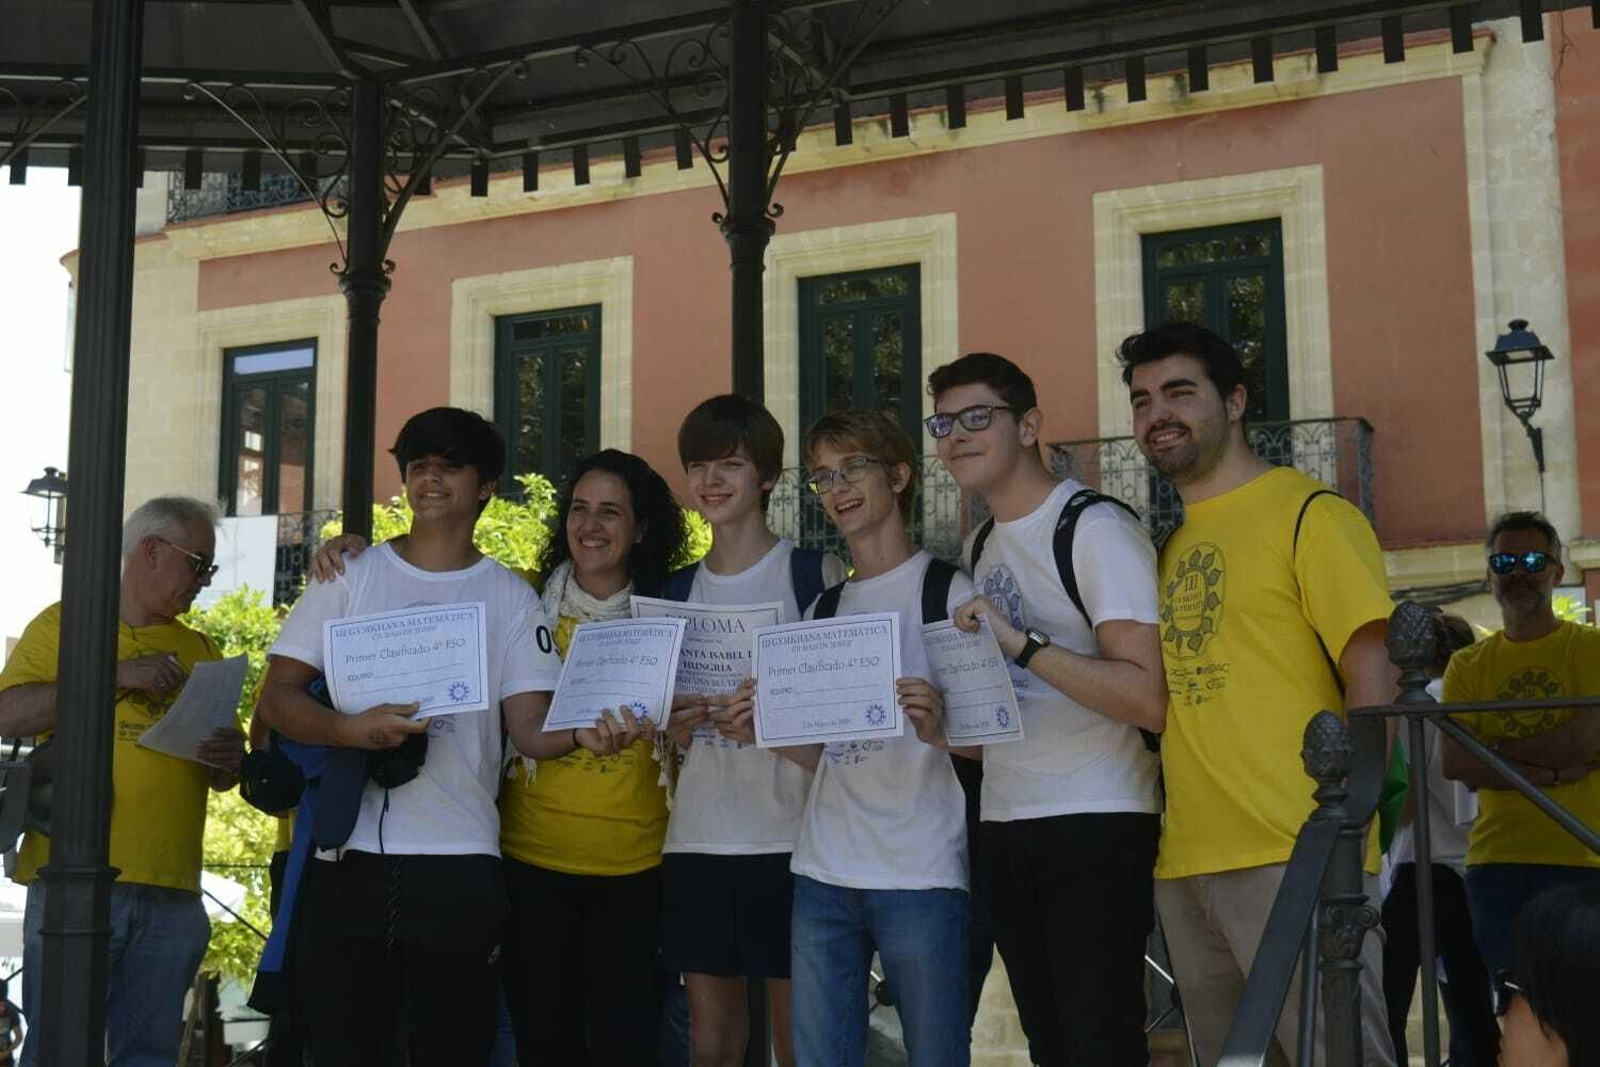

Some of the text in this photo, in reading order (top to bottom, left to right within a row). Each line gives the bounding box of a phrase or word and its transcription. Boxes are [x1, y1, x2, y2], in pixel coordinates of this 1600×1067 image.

[345, 652, 377, 665] Primer
[379, 642, 432, 660] Clasificado
[446, 637, 467, 650] ESO
[680, 648, 706, 659] ANTA
[710, 650, 744, 660] ISABEL
[768, 665, 797, 677] Primer
[798, 659, 846, 674] Clasificado
[860, 655, 880, 667] ESO
